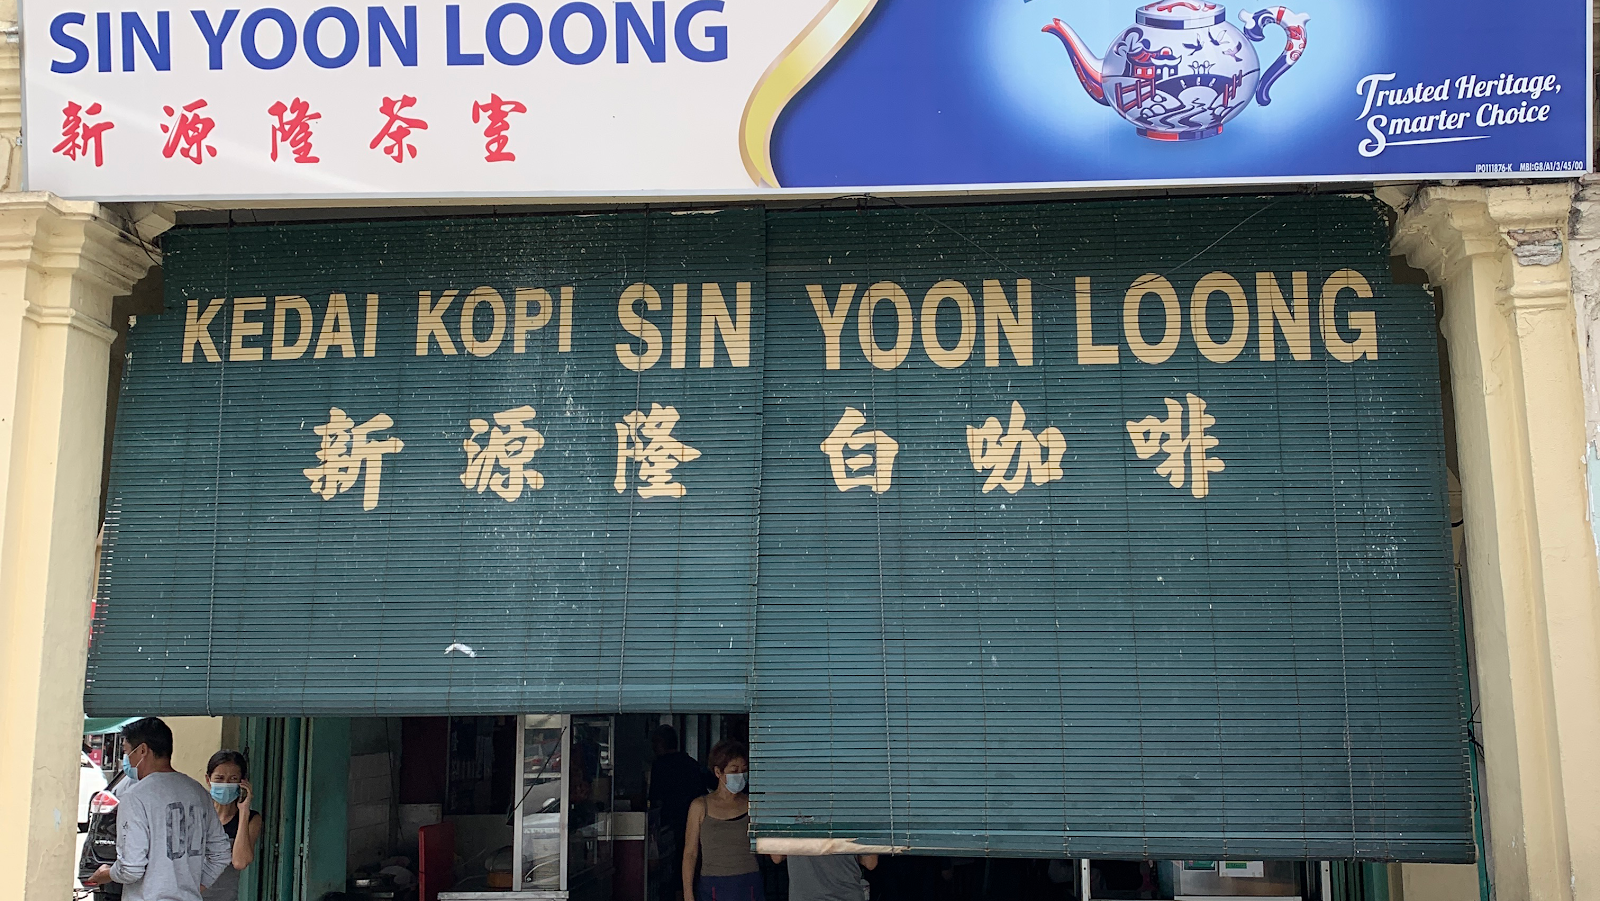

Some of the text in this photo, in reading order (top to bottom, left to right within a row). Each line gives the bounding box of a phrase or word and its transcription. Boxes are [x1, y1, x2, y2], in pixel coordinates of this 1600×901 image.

[49, 0, 728, 74] SIN YOON LOONG
[1355, 72, 1562, 121] Trusted Heritage,
[1358, 101, 1551, 158] Smarter Choice
[181, 268, 1379, 372] KEDAI KOPI SIN YOON LOONG
